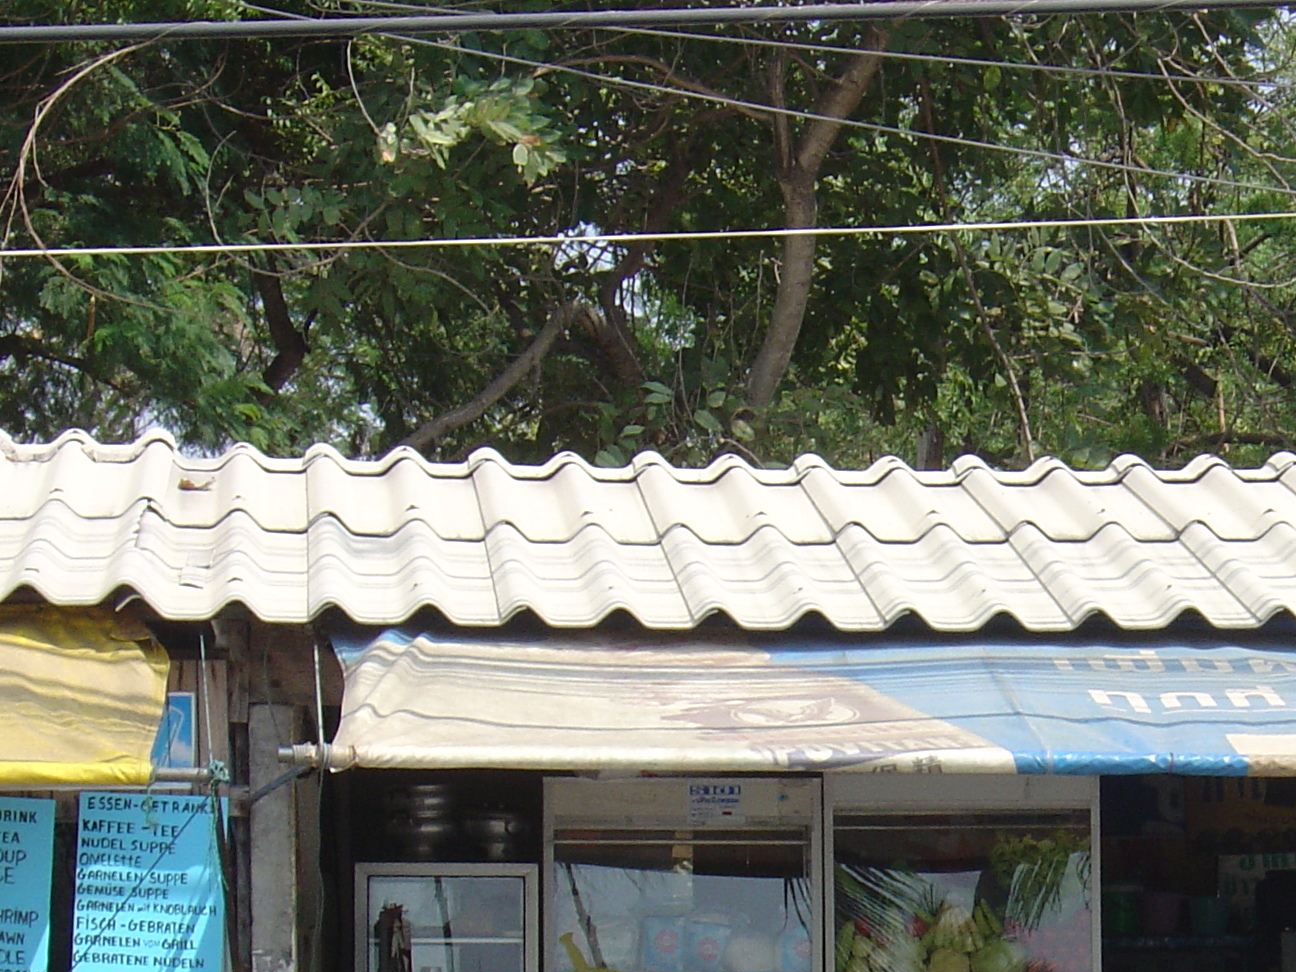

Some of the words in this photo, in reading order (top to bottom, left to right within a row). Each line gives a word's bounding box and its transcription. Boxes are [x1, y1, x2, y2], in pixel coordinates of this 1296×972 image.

[81, 837, 126, 850] NUDEL
[131, 840, 176, 854] SUPPE
[77, 868, 144, 882] GARNELEN
[150, 873, 187, 886] SUPPE
[132, 888, 169, 899] SUPPE
[153, 957, 204, 968] NUDELN
